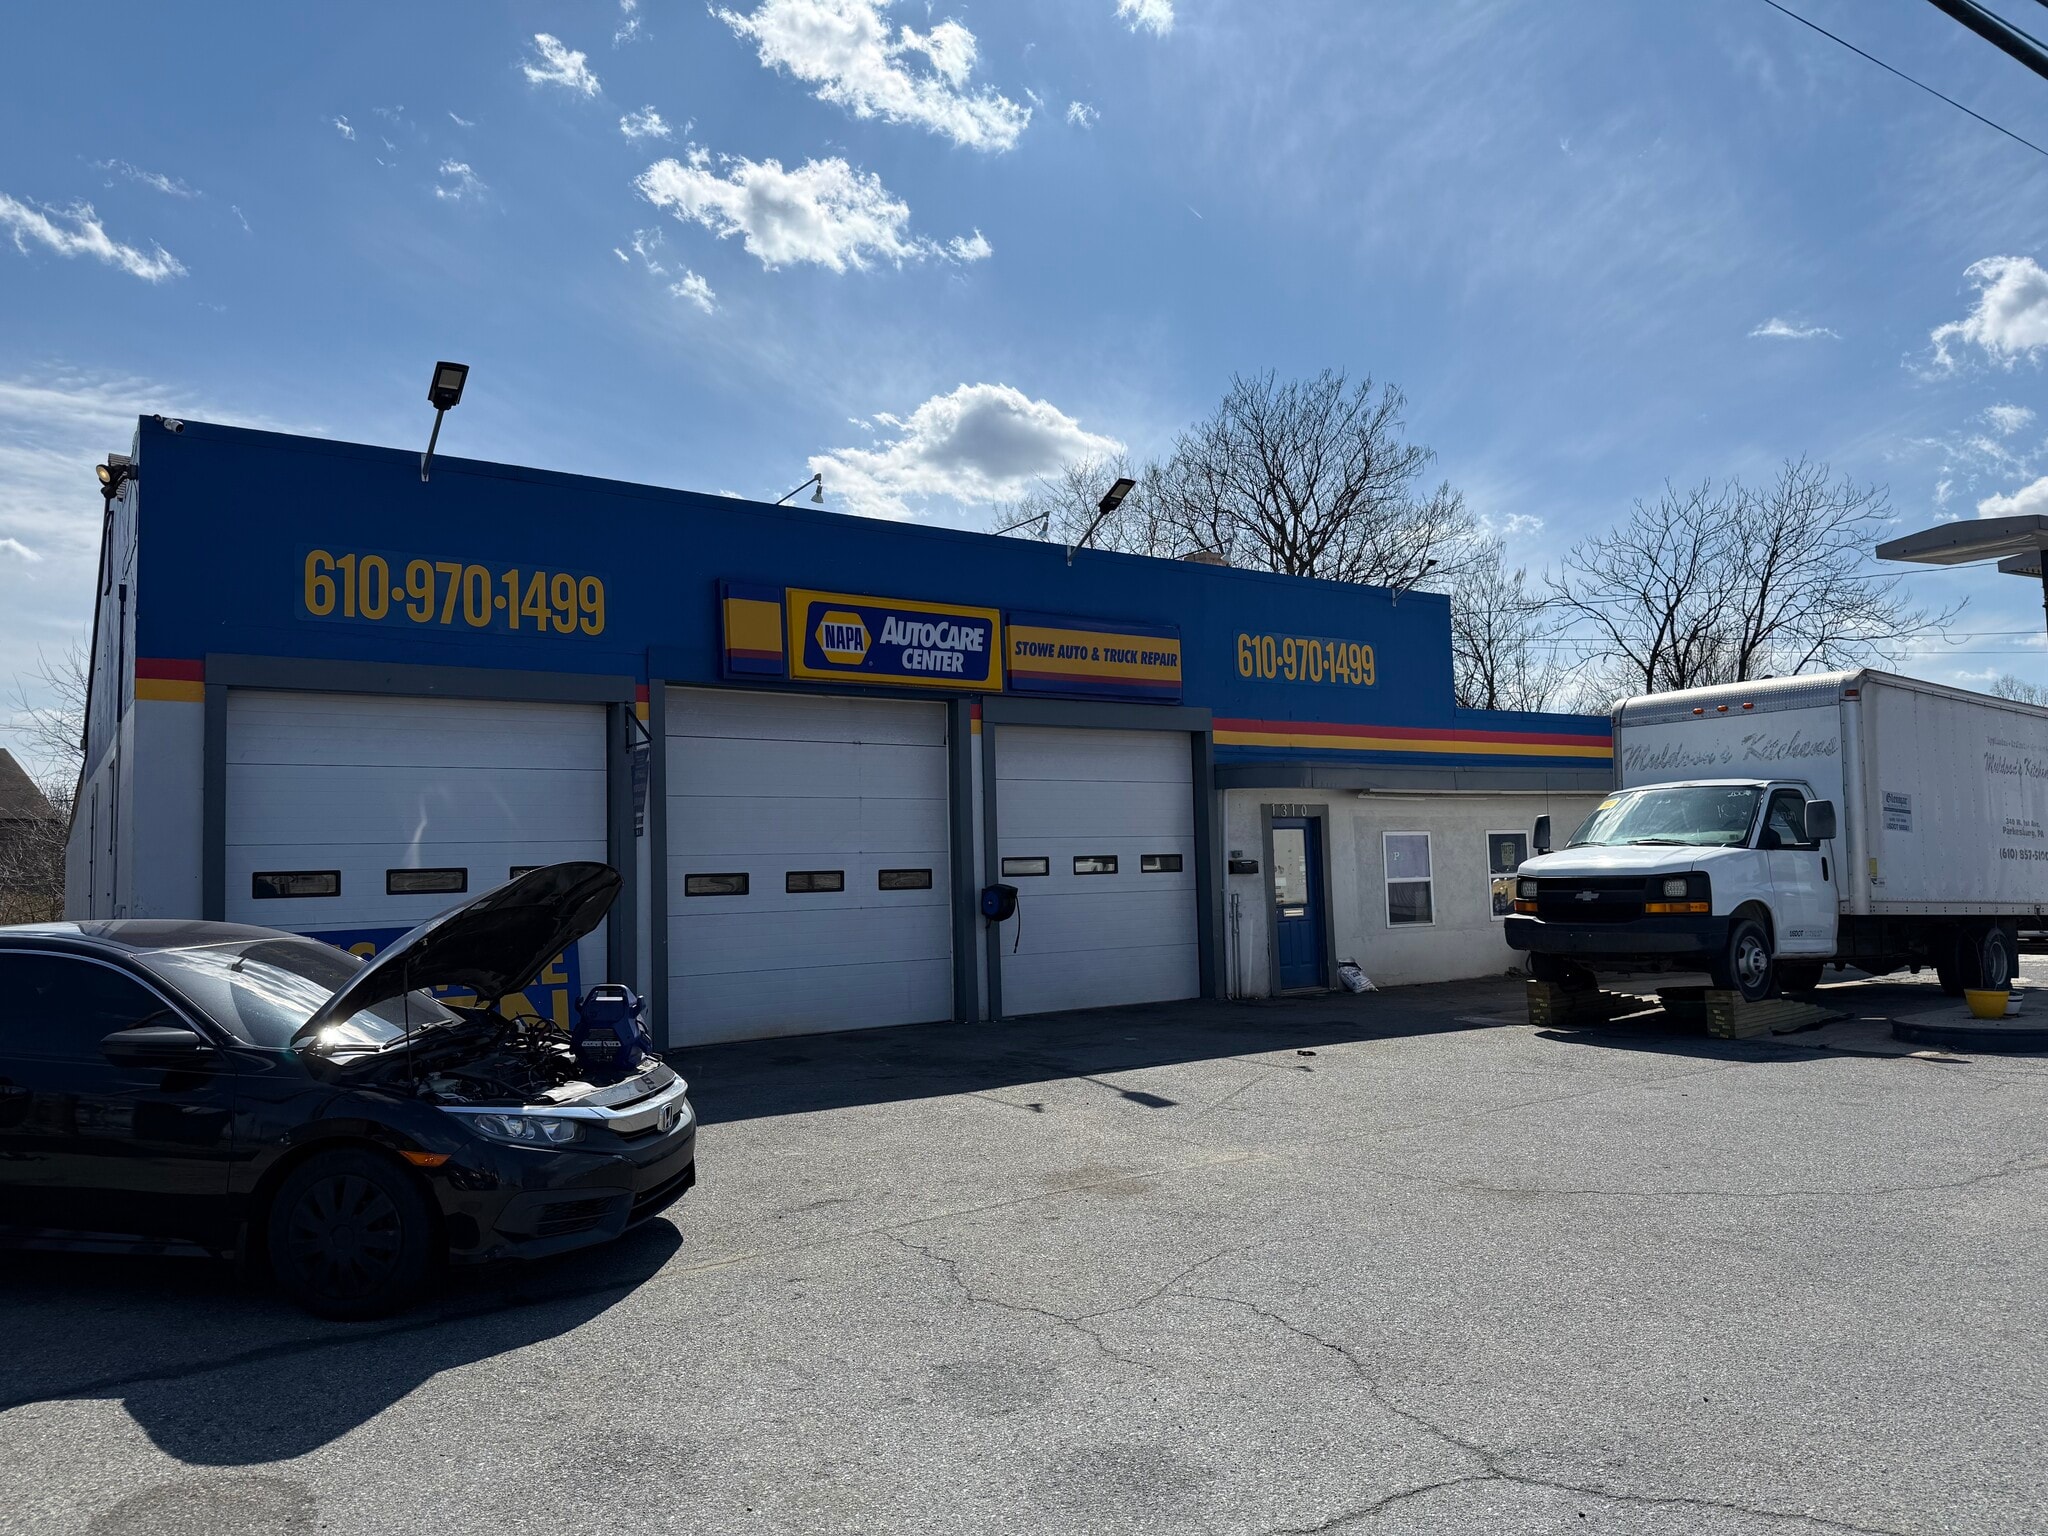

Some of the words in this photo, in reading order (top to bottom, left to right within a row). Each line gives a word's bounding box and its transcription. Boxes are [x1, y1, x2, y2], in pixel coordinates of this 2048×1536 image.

[824, 624, 864, 651] NAPA
[901, 648, 964, 673] CENTER
[1015, 641, 1054, 657] STOWE
[1057, 644, 1088, 660] AUTO
[1091, 647, 1099, 661] &
[1104, 648, 1138, 664] TRUCK
[1140, 651, 1178, 667] REPAIR
[1741, 730, 1838, 762] Kitchens
[1271, 803, 1307, 817] 1310
[2037, 829, 2045, 838] PA
[1999, 847, 2018, 861] (610)
